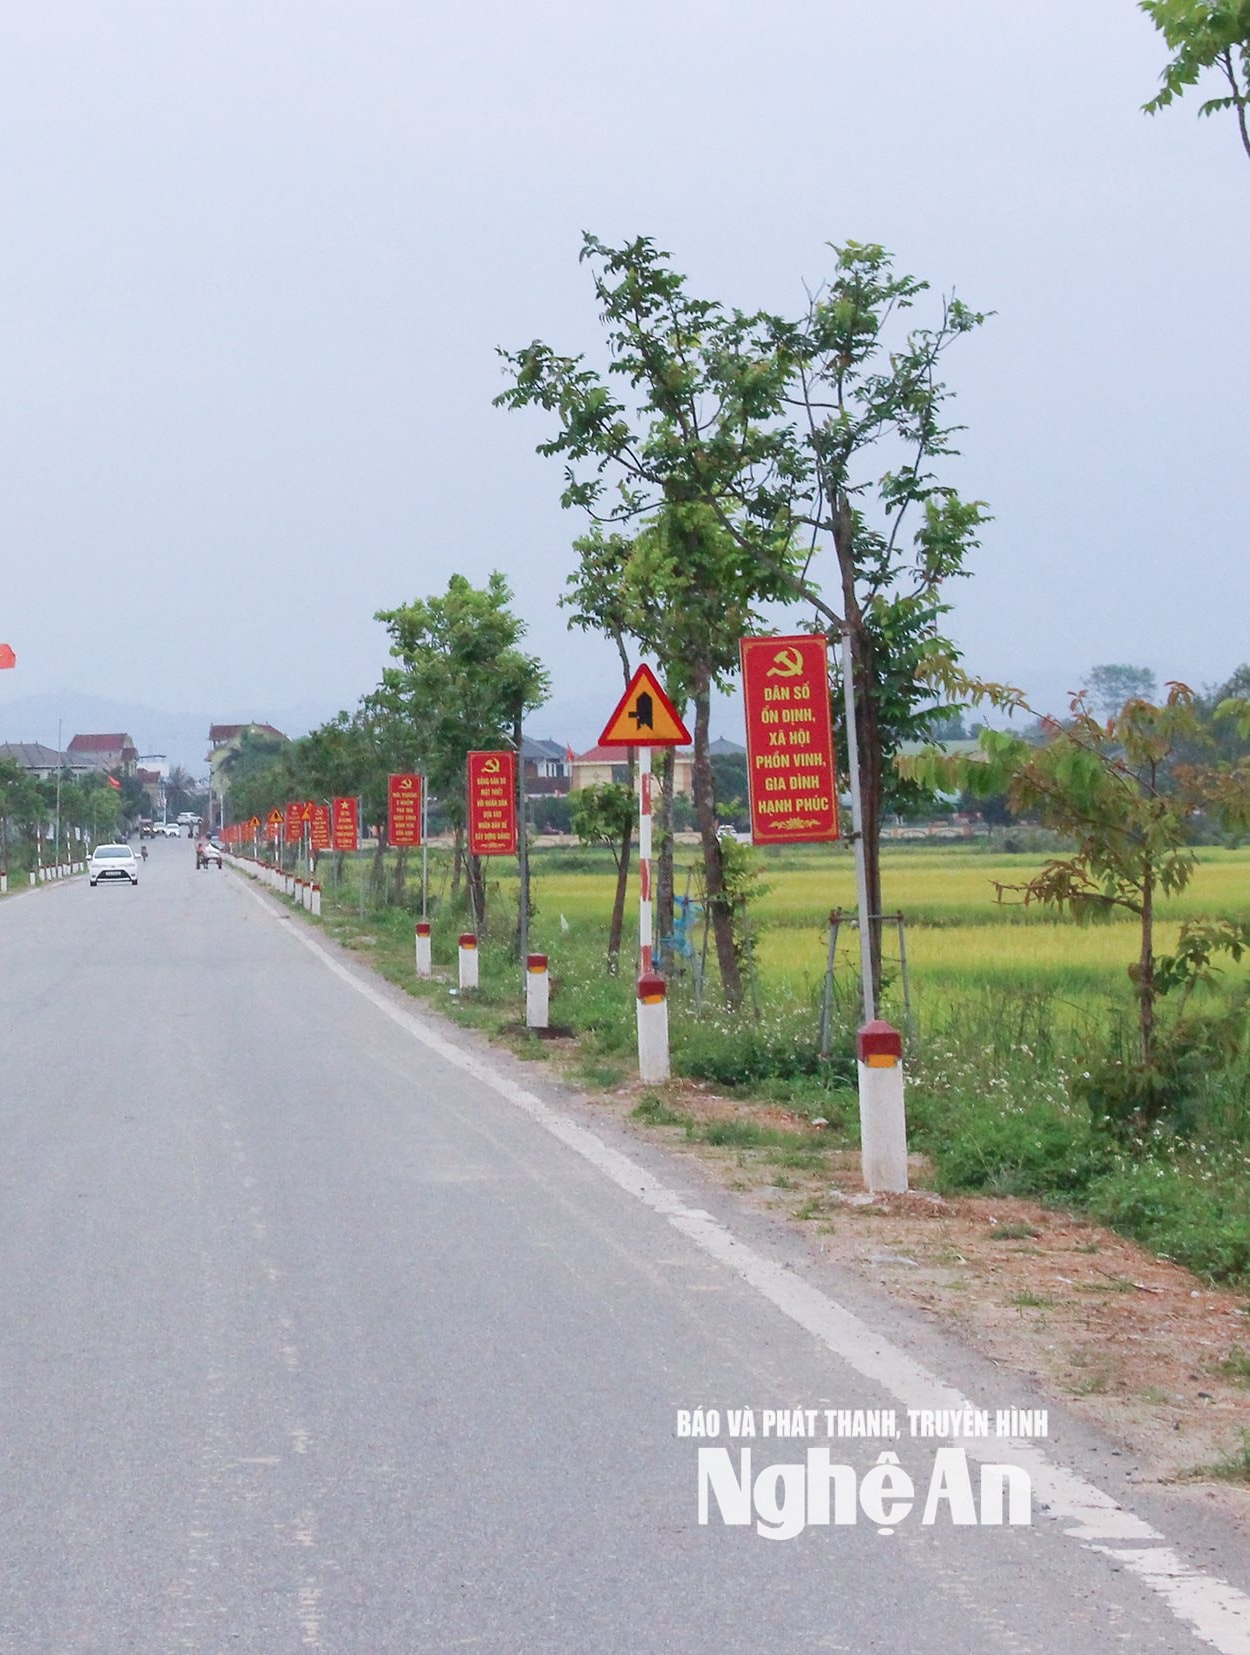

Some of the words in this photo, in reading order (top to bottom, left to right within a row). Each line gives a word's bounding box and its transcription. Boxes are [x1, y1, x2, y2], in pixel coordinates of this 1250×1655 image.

[764, 685, 790, 701] DÂN
[782, 708, 815, 725] ĐỊNH,
[770, 730, 786, 745] XÃ
[790, 729, 810, 747] HỘI
[793, 753, 826, 767] VINH,
[765, 777, 786, 790] GIA
[790, 774, 819, 790] ĐÌNH
[759, 799, 792, 816] HẠNH
[796, 795, 829, 811] PHÚC
